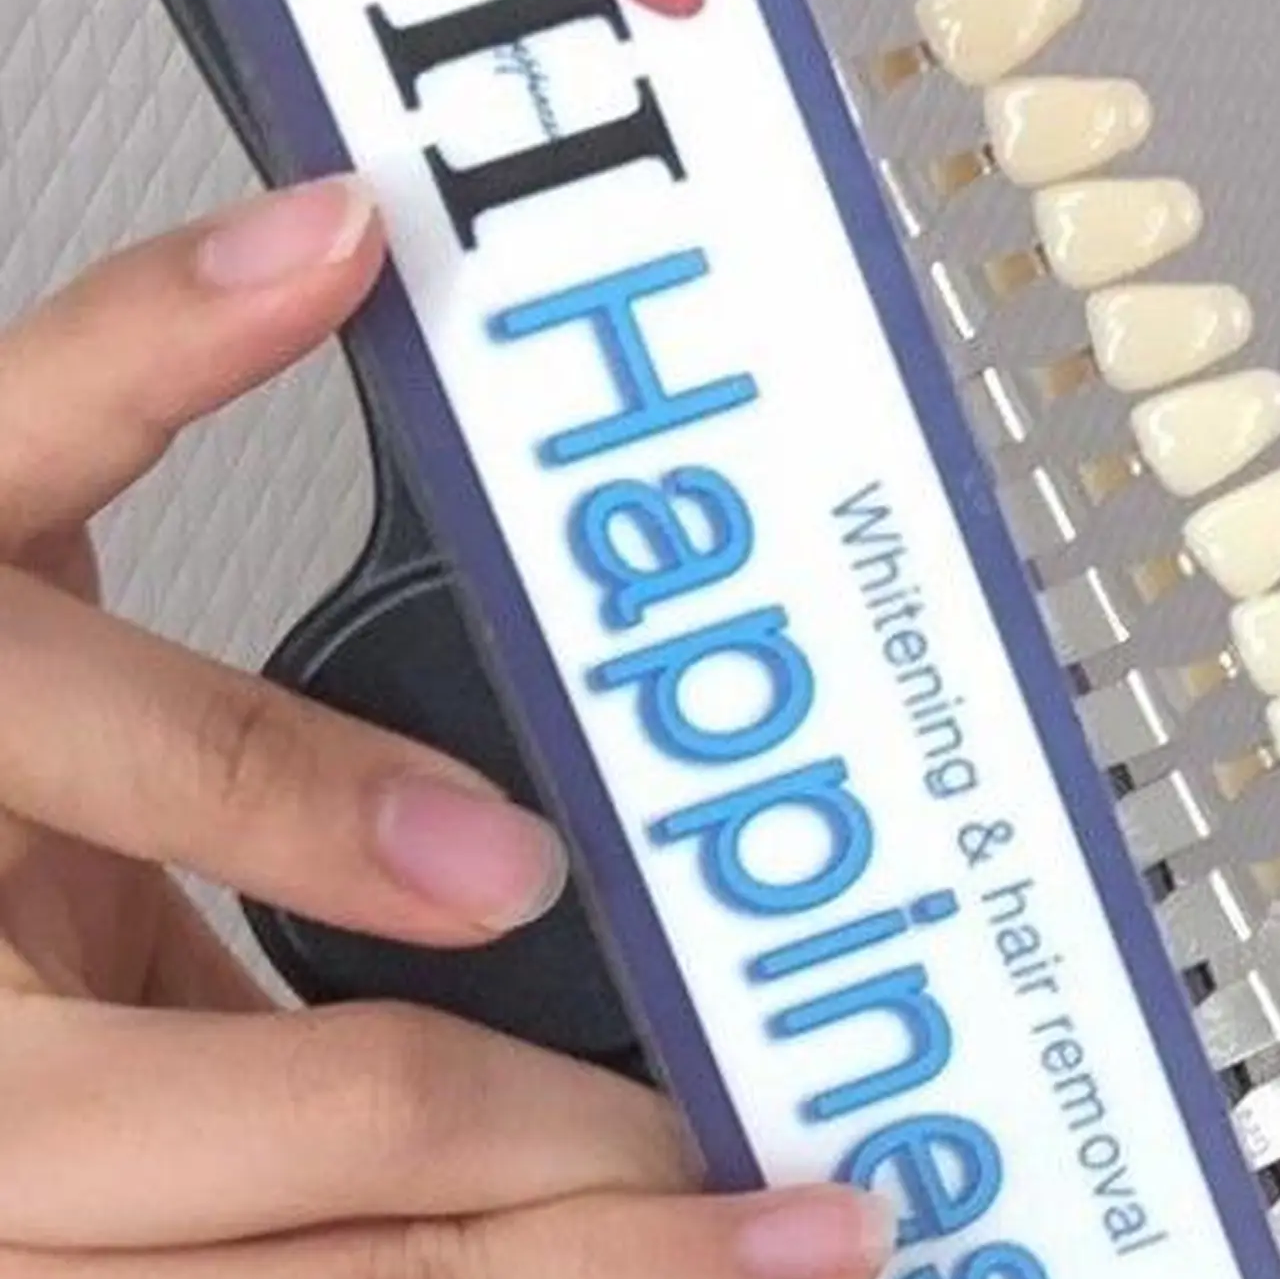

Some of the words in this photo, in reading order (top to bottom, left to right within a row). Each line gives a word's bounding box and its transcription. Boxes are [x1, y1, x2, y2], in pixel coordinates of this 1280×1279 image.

[831, 480, 980, 799] Whitening
[957, 818, 1015, 867] &
[981, 878, 1062, 1002] hair
[1031, 1012, 1169, 1256] removal
